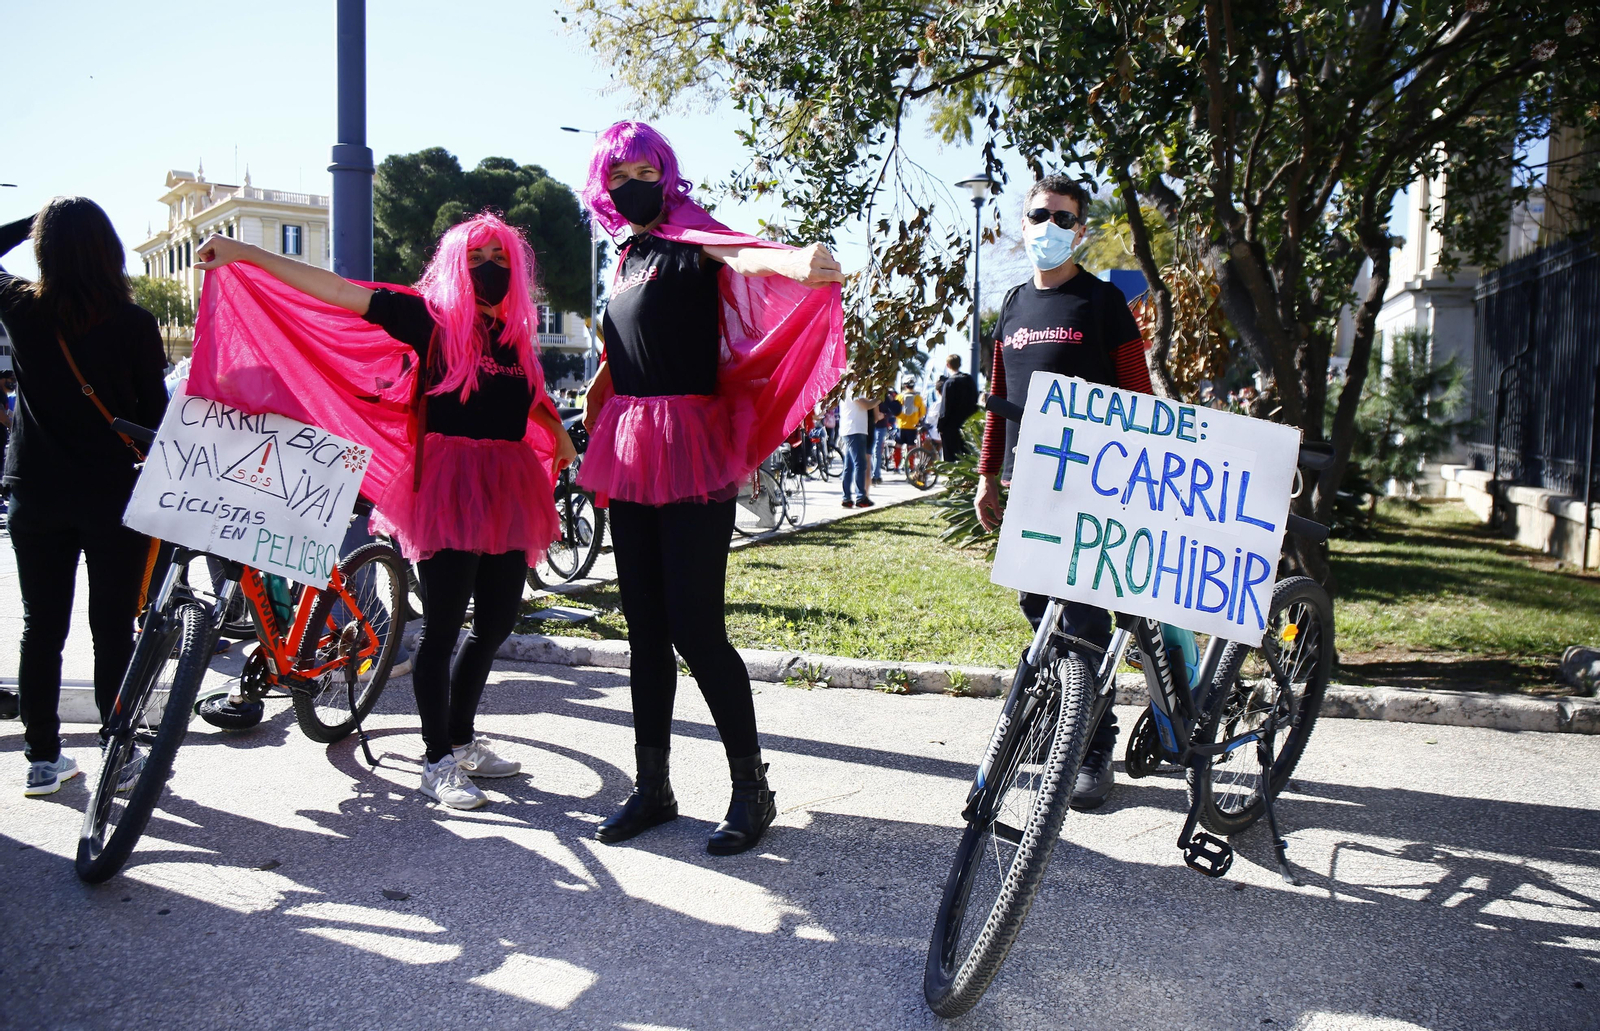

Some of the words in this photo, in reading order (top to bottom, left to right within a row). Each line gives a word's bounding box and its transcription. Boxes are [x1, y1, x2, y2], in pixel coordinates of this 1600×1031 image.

[1029, 327, 1083, 341] invisible
[181, 396, 278, 435] CARRIL
[1040, 379, 1209, 443] ALCALDE:
[286, 468, 345, 527] ¡YA!
[219, 525, 248, 541] EN
